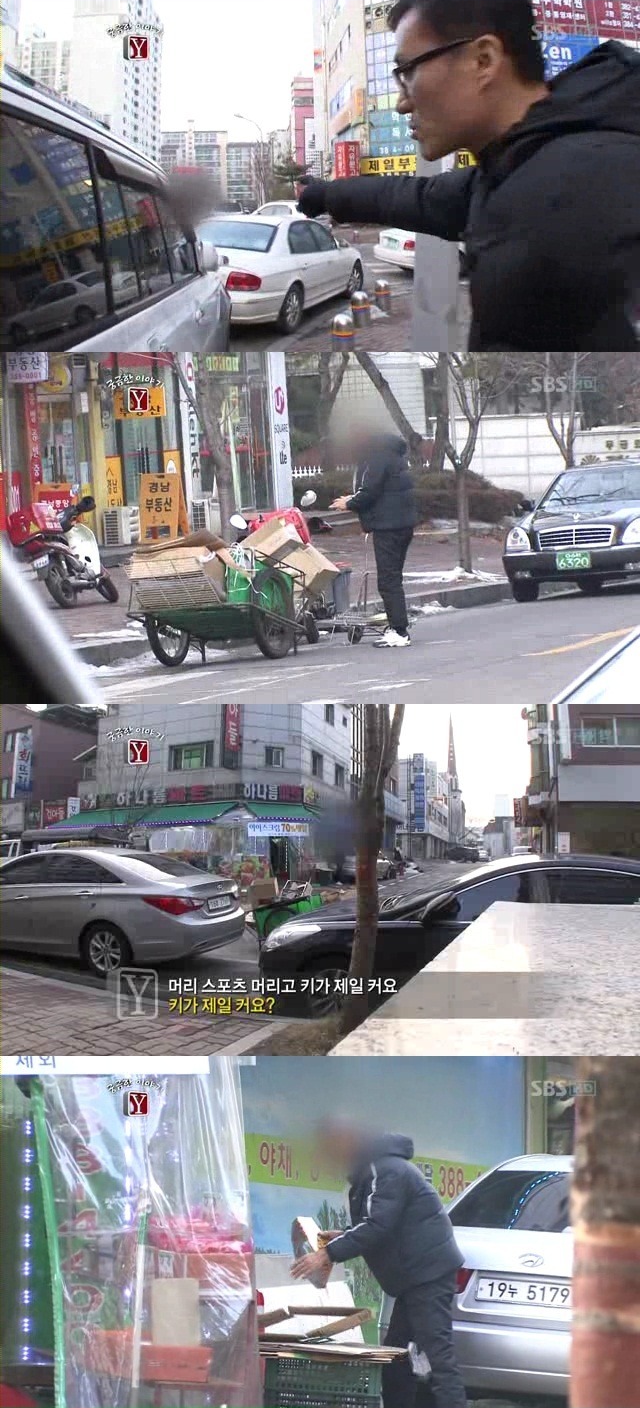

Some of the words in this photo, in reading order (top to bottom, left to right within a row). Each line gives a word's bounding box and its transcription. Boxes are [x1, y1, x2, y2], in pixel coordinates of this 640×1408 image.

[368, 157, 416, 172] 제일부
[148, 482, 170, 494] 경남
[145, 497, 173, 513] 부동산
[558, 557, 589, 569] 6320
[487, 1281, 518, 1298] 19누
[527, 1285, 570, 1304] 5179
